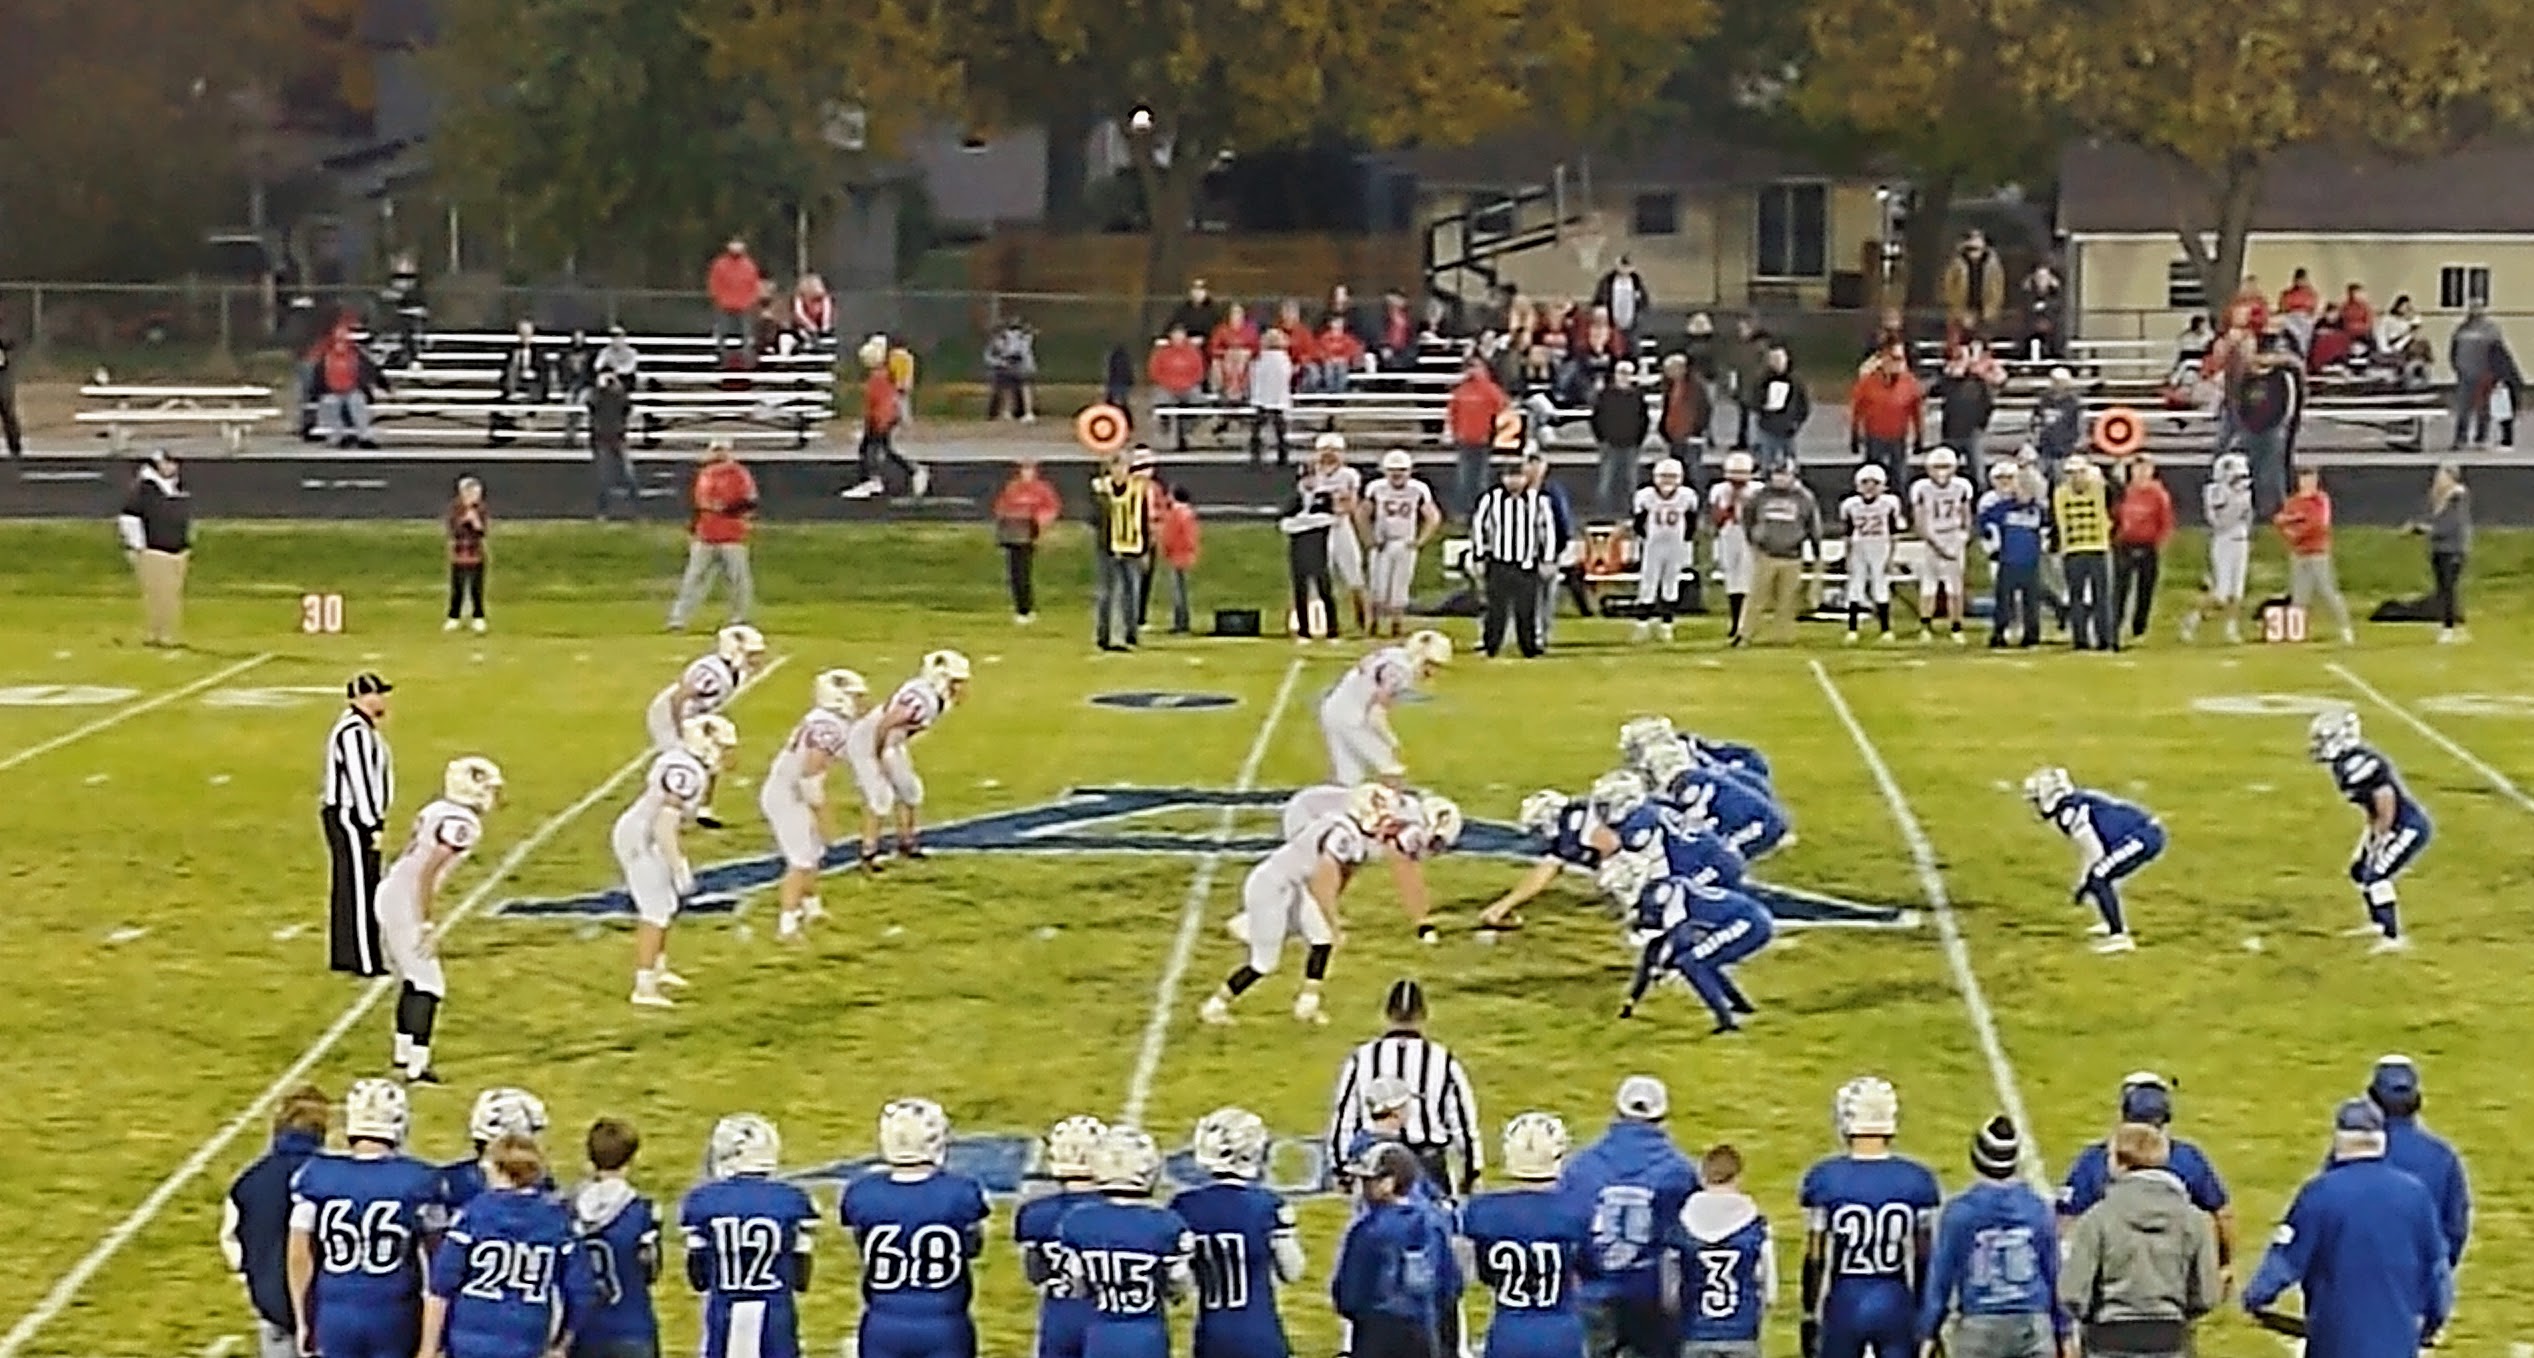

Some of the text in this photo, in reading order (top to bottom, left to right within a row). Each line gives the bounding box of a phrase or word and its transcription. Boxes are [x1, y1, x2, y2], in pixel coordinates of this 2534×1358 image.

[1494, 411, 1521, 449] 2
[302, 594, 343, 634] 30
[1289, 599, 1327, 636] 0
[2264, 606, 2305, 641] 30
[319, 1199, 410, 1274] 66
[711, 1217, 783, 1291] 12
[865, 1224, 961, 1290] 68
[1832, 1203, 1914, 1274] 20
[462, 1239, 556, 1304] 24
[1081, 1250, 1159, 1314] 15
[1488, 1240, 1562, 1308] 21
[1699, 1250, 1741, 1318] 3
